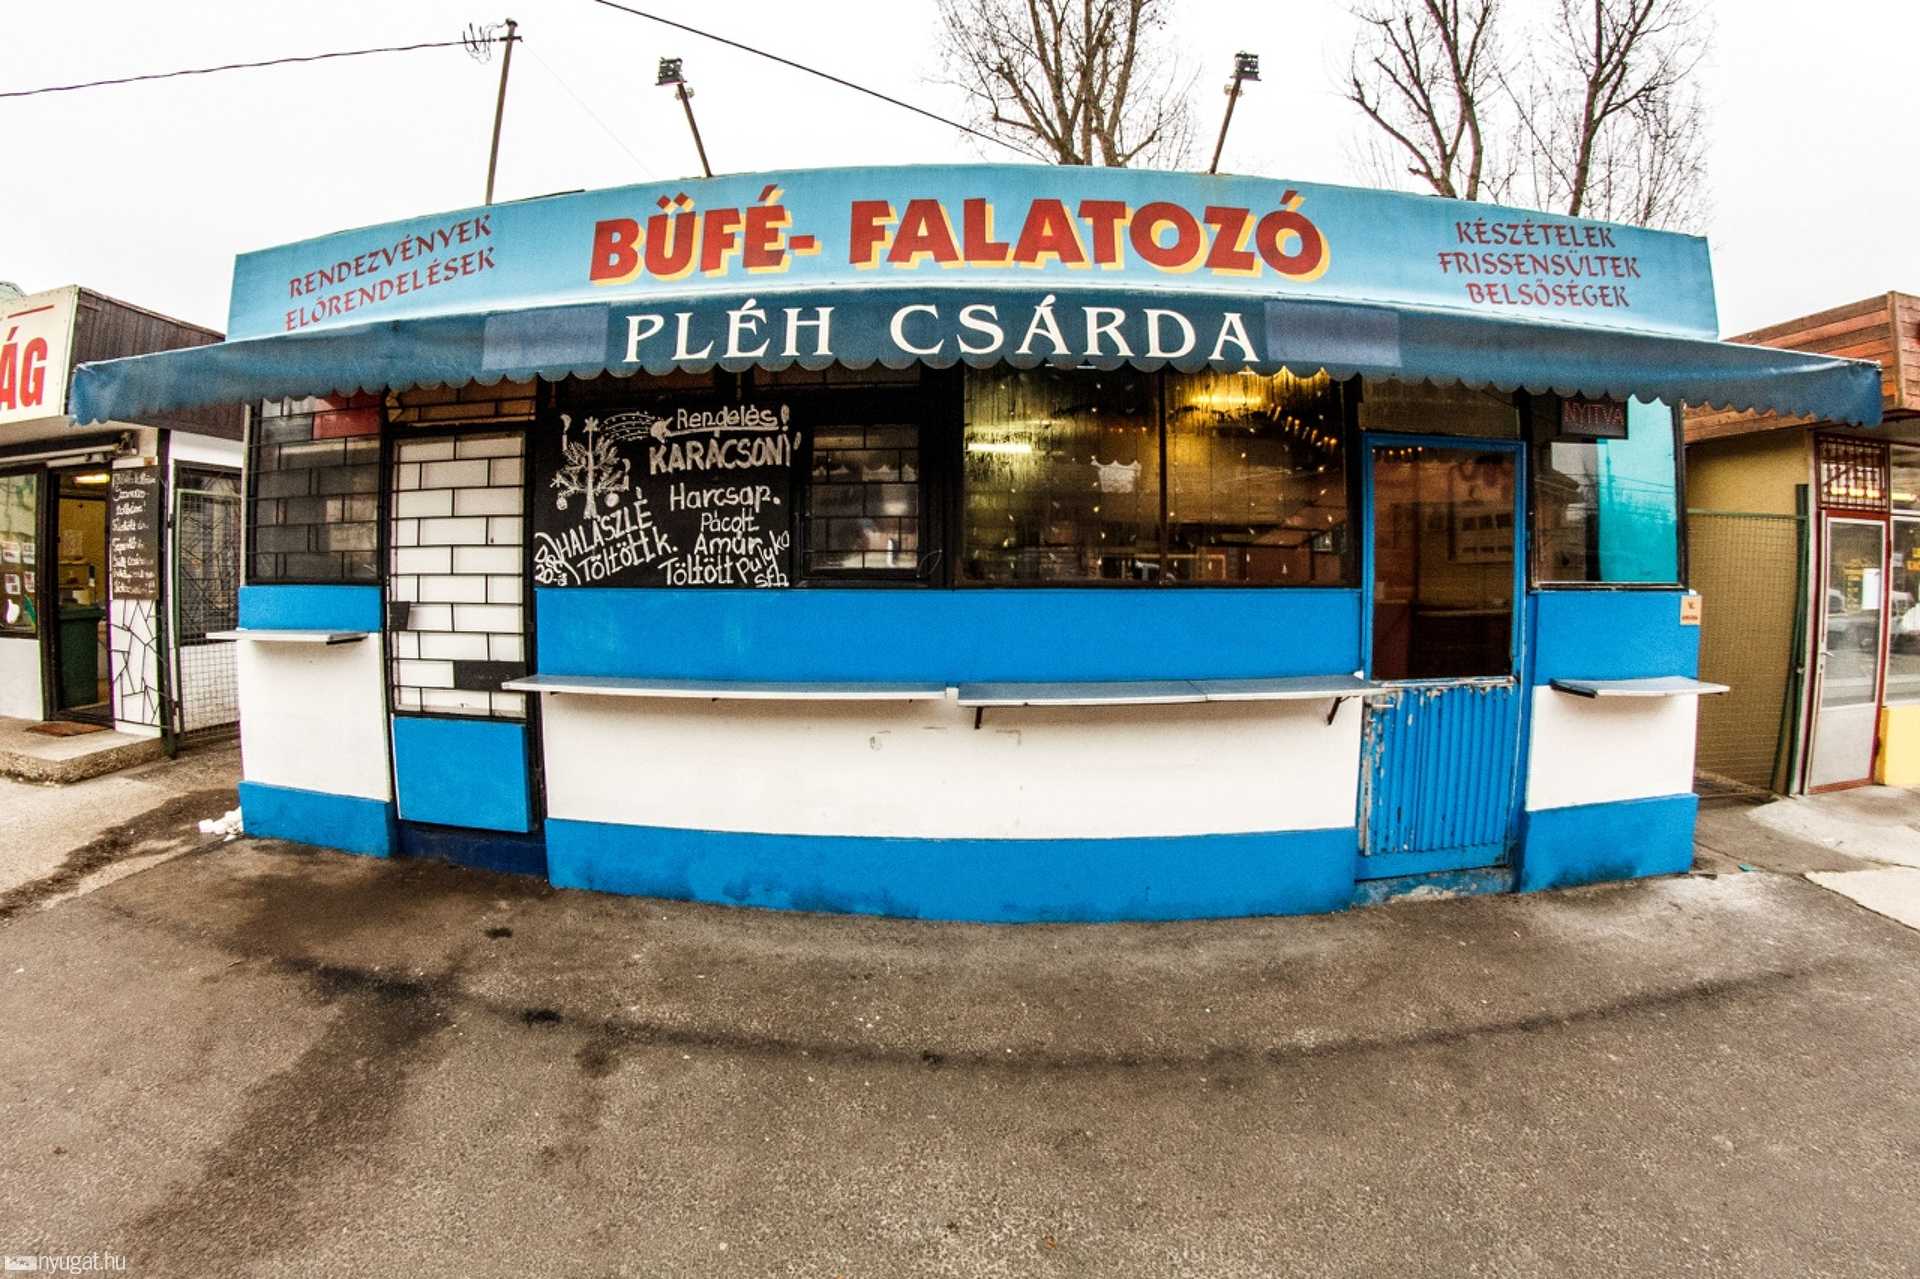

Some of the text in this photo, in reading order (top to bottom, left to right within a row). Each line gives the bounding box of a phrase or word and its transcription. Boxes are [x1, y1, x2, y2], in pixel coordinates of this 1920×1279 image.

[289, 214, 492, 298] RENDEZVÉNYEK
[589, 184, 1330, 286] BÜFÉ- FALATOZÓ
[1456, 217, 1616, 248] KÉSZÉTELEK
[1437, 249, 1641, 279] FRISSENSÜLTEK
[1465, 279, 1630, 308] BELSŐSÉGEK
[622, 294, 1261, 363] PLÉH CSÁRDA
